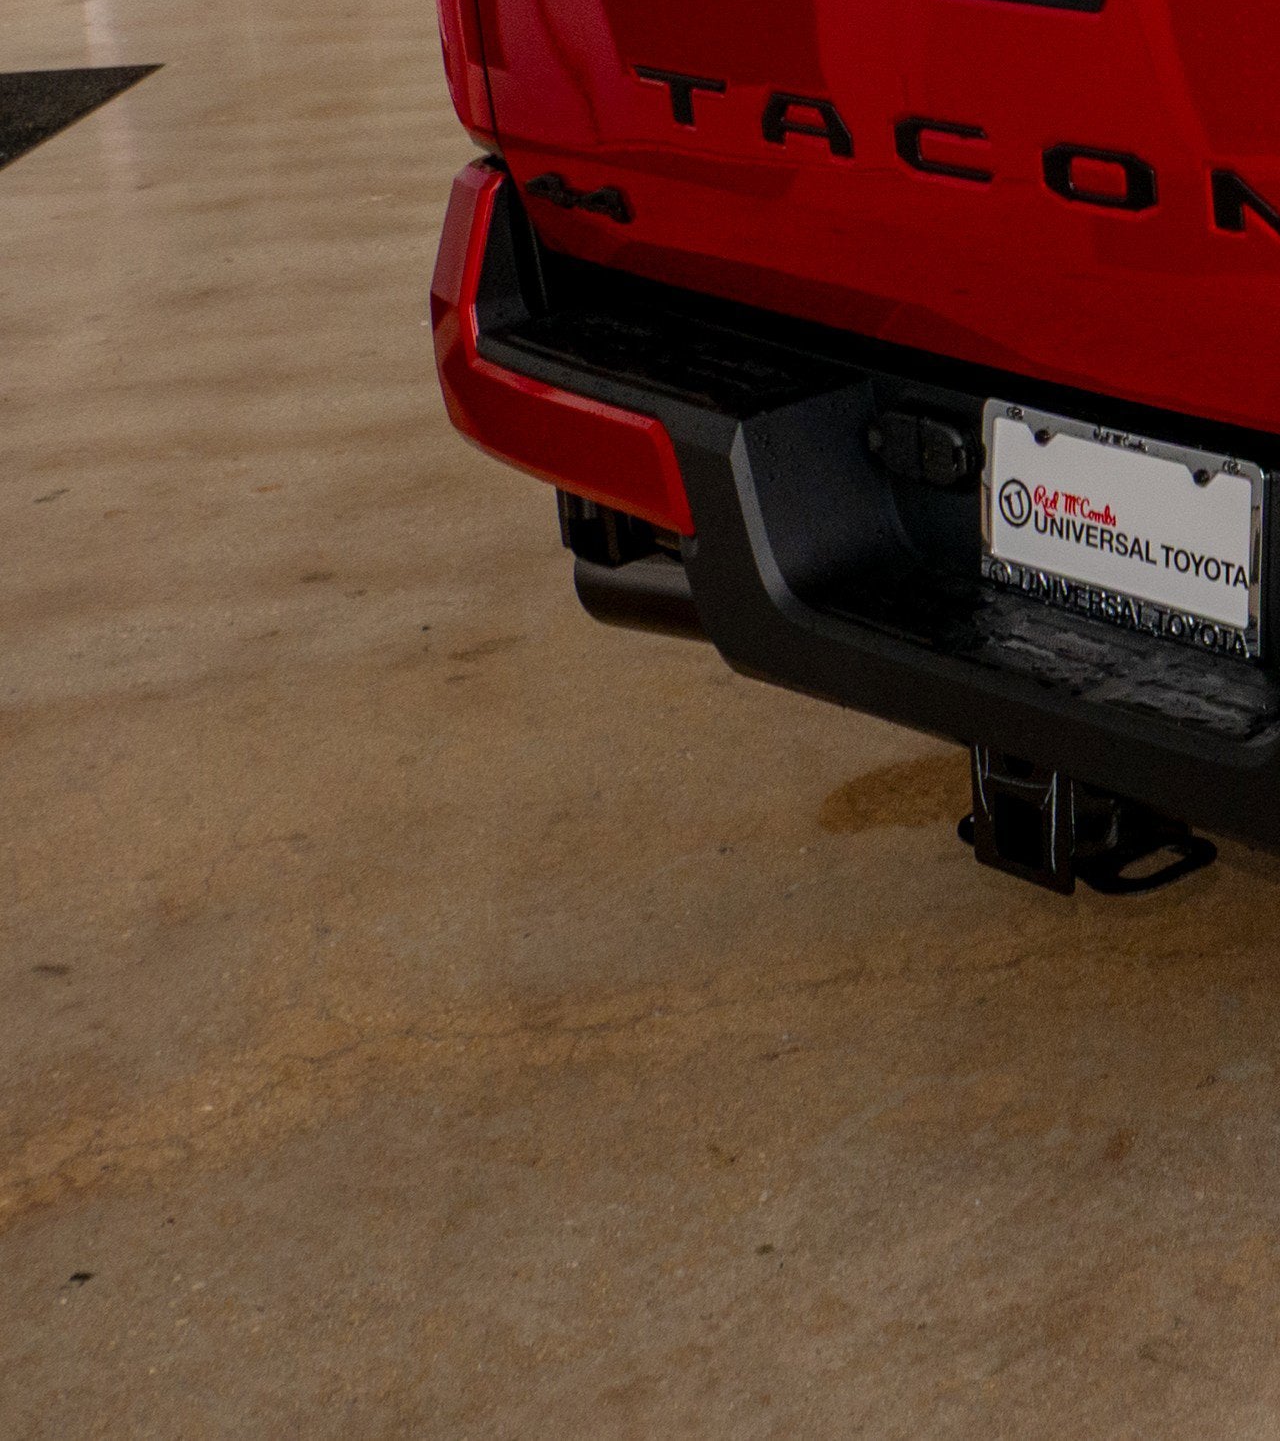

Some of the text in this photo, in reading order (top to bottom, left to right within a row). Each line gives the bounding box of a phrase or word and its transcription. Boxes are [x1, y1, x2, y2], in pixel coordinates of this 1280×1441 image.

[1033, 484, 1060, 519] Red
[1033, 510, 1249, 589] UNIVERSAL TOYOTA
[1018, 567, 1151, 630] UNIVERSAL
[1154, 607, 1250, 658] TOYOTA
